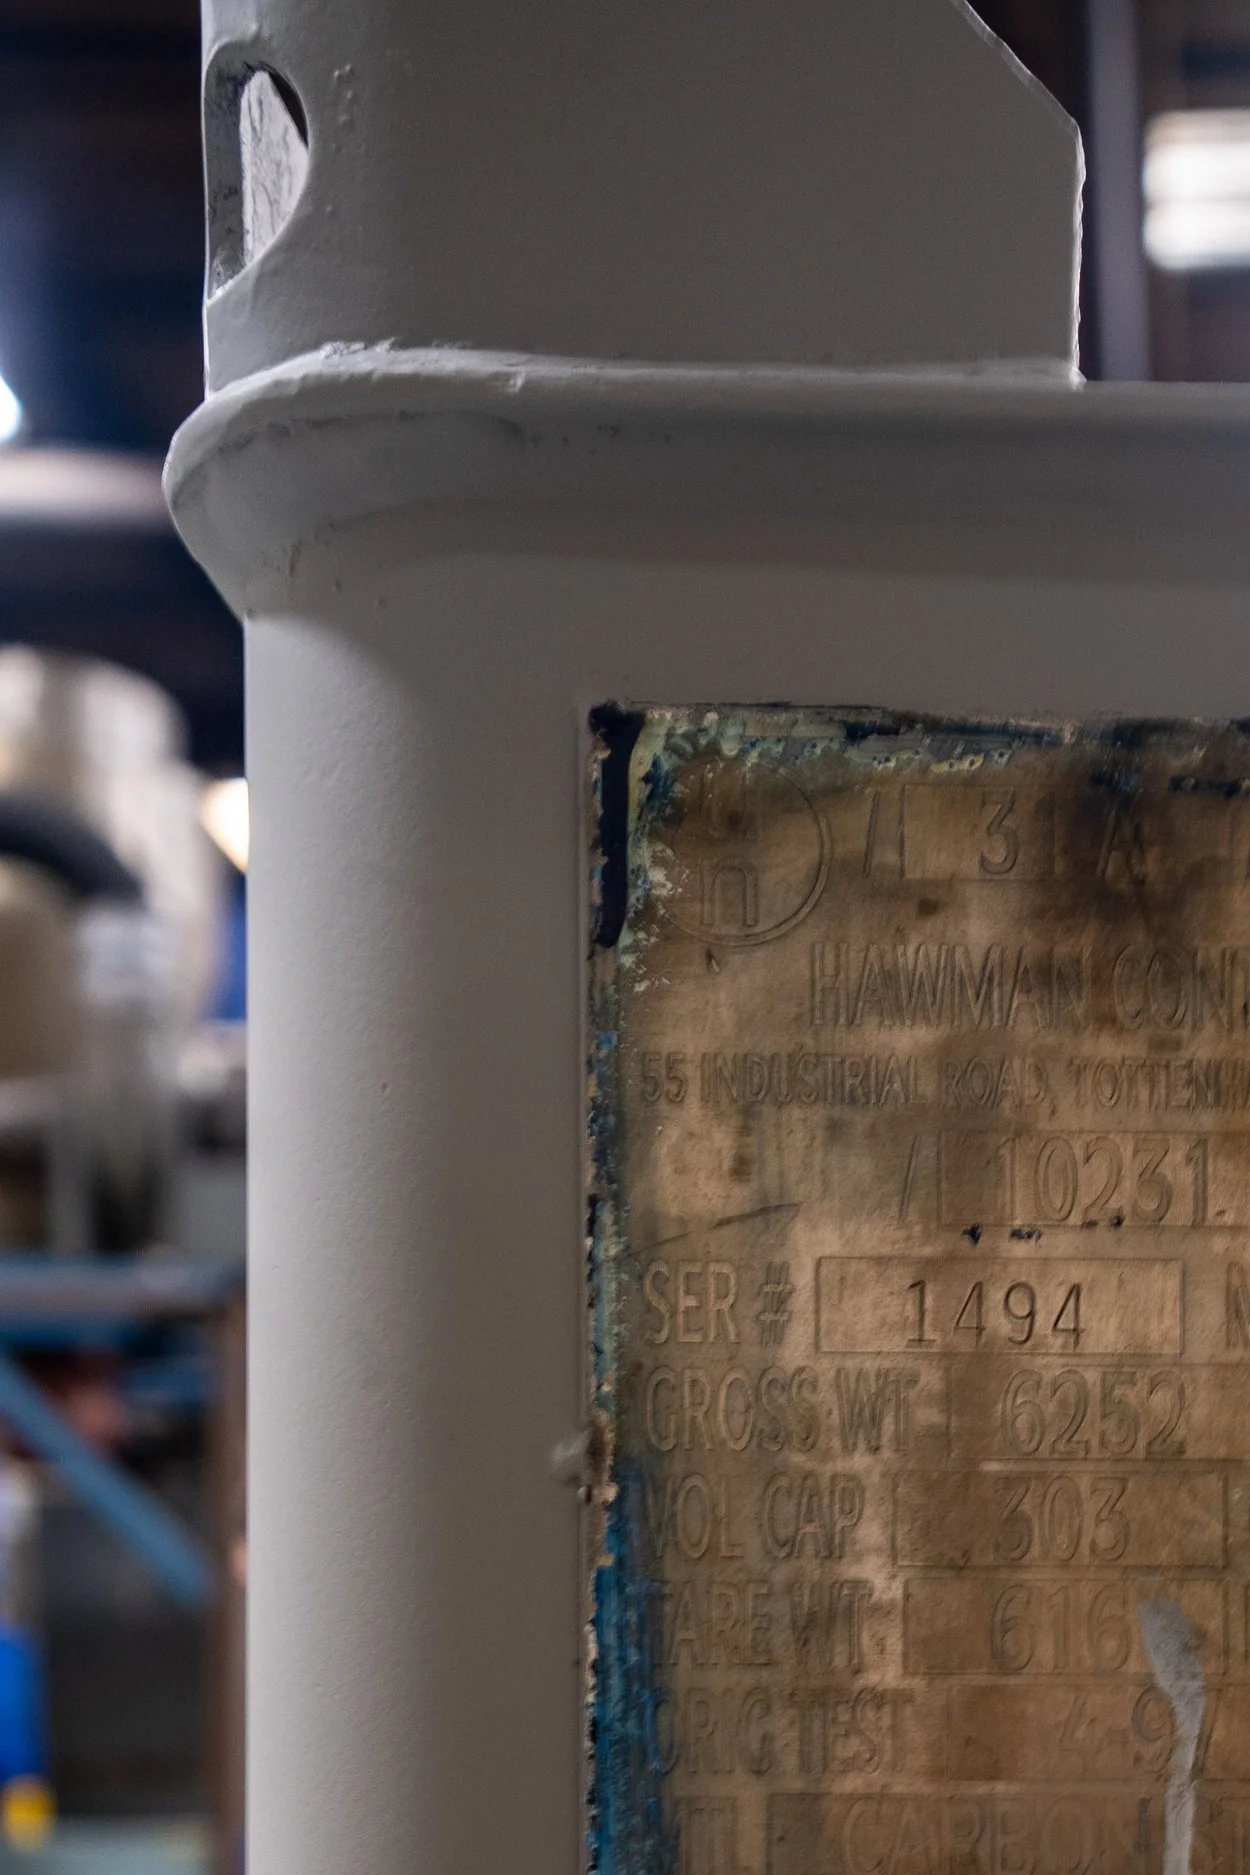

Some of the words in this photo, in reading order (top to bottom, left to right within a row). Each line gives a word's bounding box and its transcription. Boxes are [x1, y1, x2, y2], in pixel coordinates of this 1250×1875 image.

[808, 942, 1093, 1032] HAWMAN
[639, 1050, 688, 1101] 55
[701, 1051, 922, 1105] INDUSTRIAL
[995, 1135, 1212, 1226] 10231
[643, 1259, 740, 1345] SER
[905, 1280, 1085, 1347] 1494
[645, 1365, 819, 1453] GROSS
[834, 1366, 921, 1455] WT
[1001, 1368, 1187, 1459] 6252
[760, 1472, 866, 1560] CAP
[998, 1473, 1130, 1561] 303
[788, 1578, 875, 1670] WT
[990, 1582, 1134, 1671] 616
